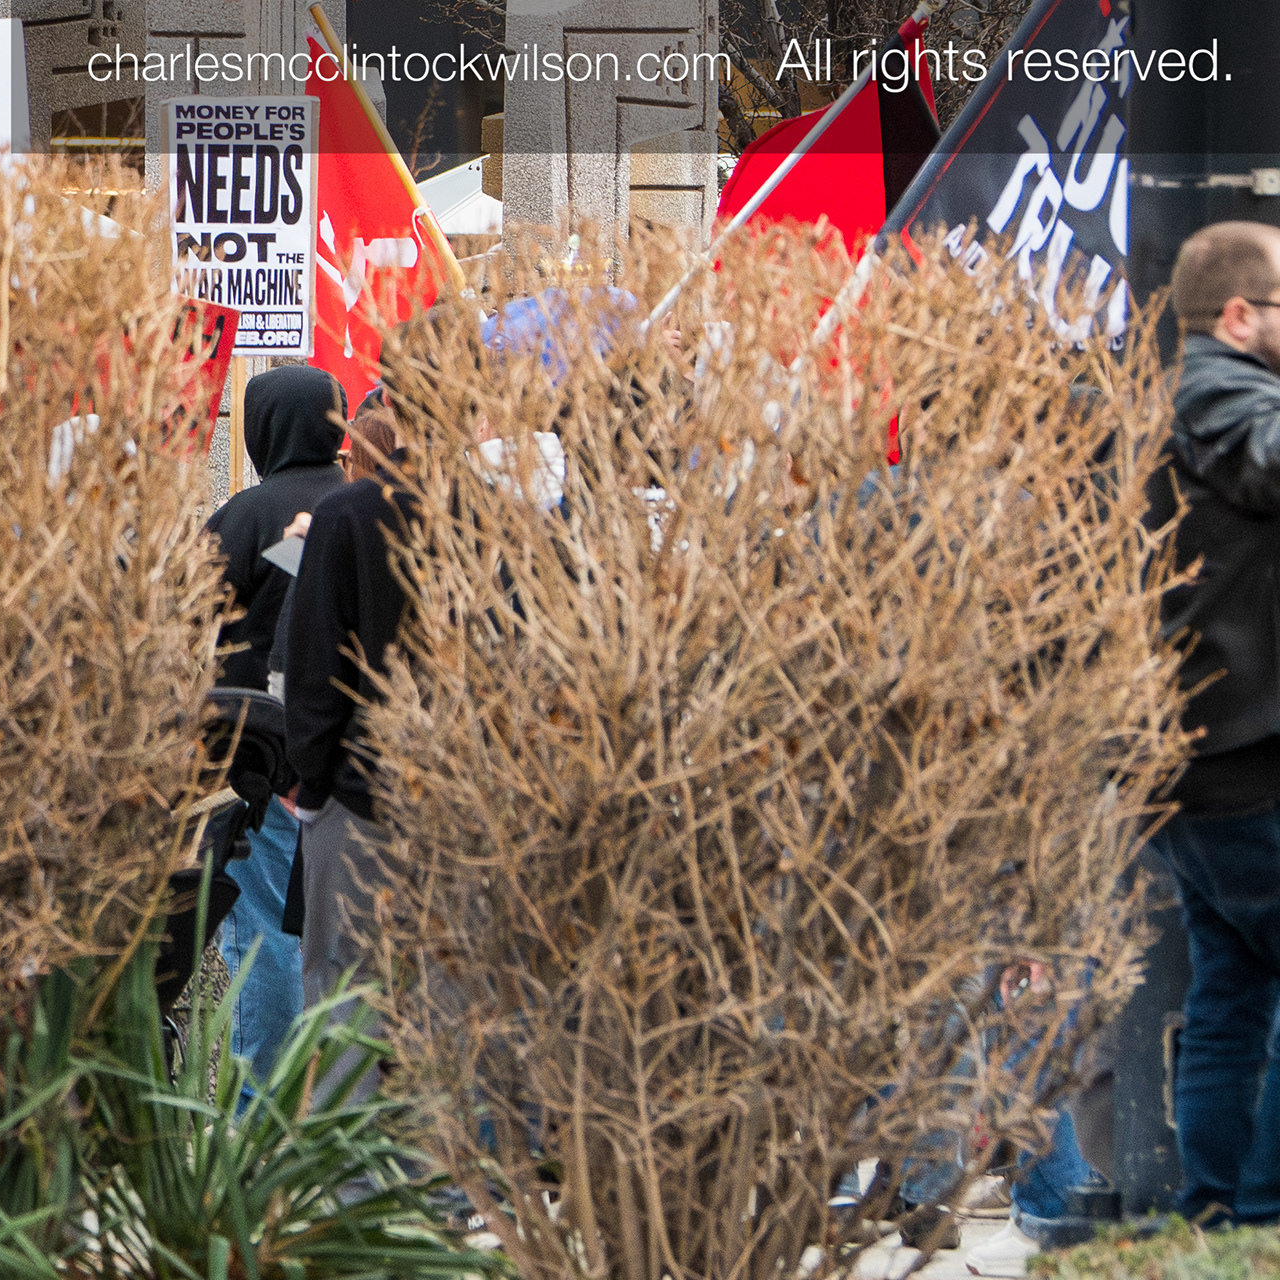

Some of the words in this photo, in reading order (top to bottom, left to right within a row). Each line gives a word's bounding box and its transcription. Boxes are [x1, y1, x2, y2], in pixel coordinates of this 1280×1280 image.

[175, 104, 260, 120] MONEY
[265, 106, 305, 121] FOR
[176, 122, 306, 141] PEOPLE'S
[176, 143, 303, 225] NEEDS
[176, 231, 277, 263] NOT
[276, 253, 305, 264] THE
[227, 268, 303, 306] MACHINE
[235, 330, 301, 346] EB.ORG
